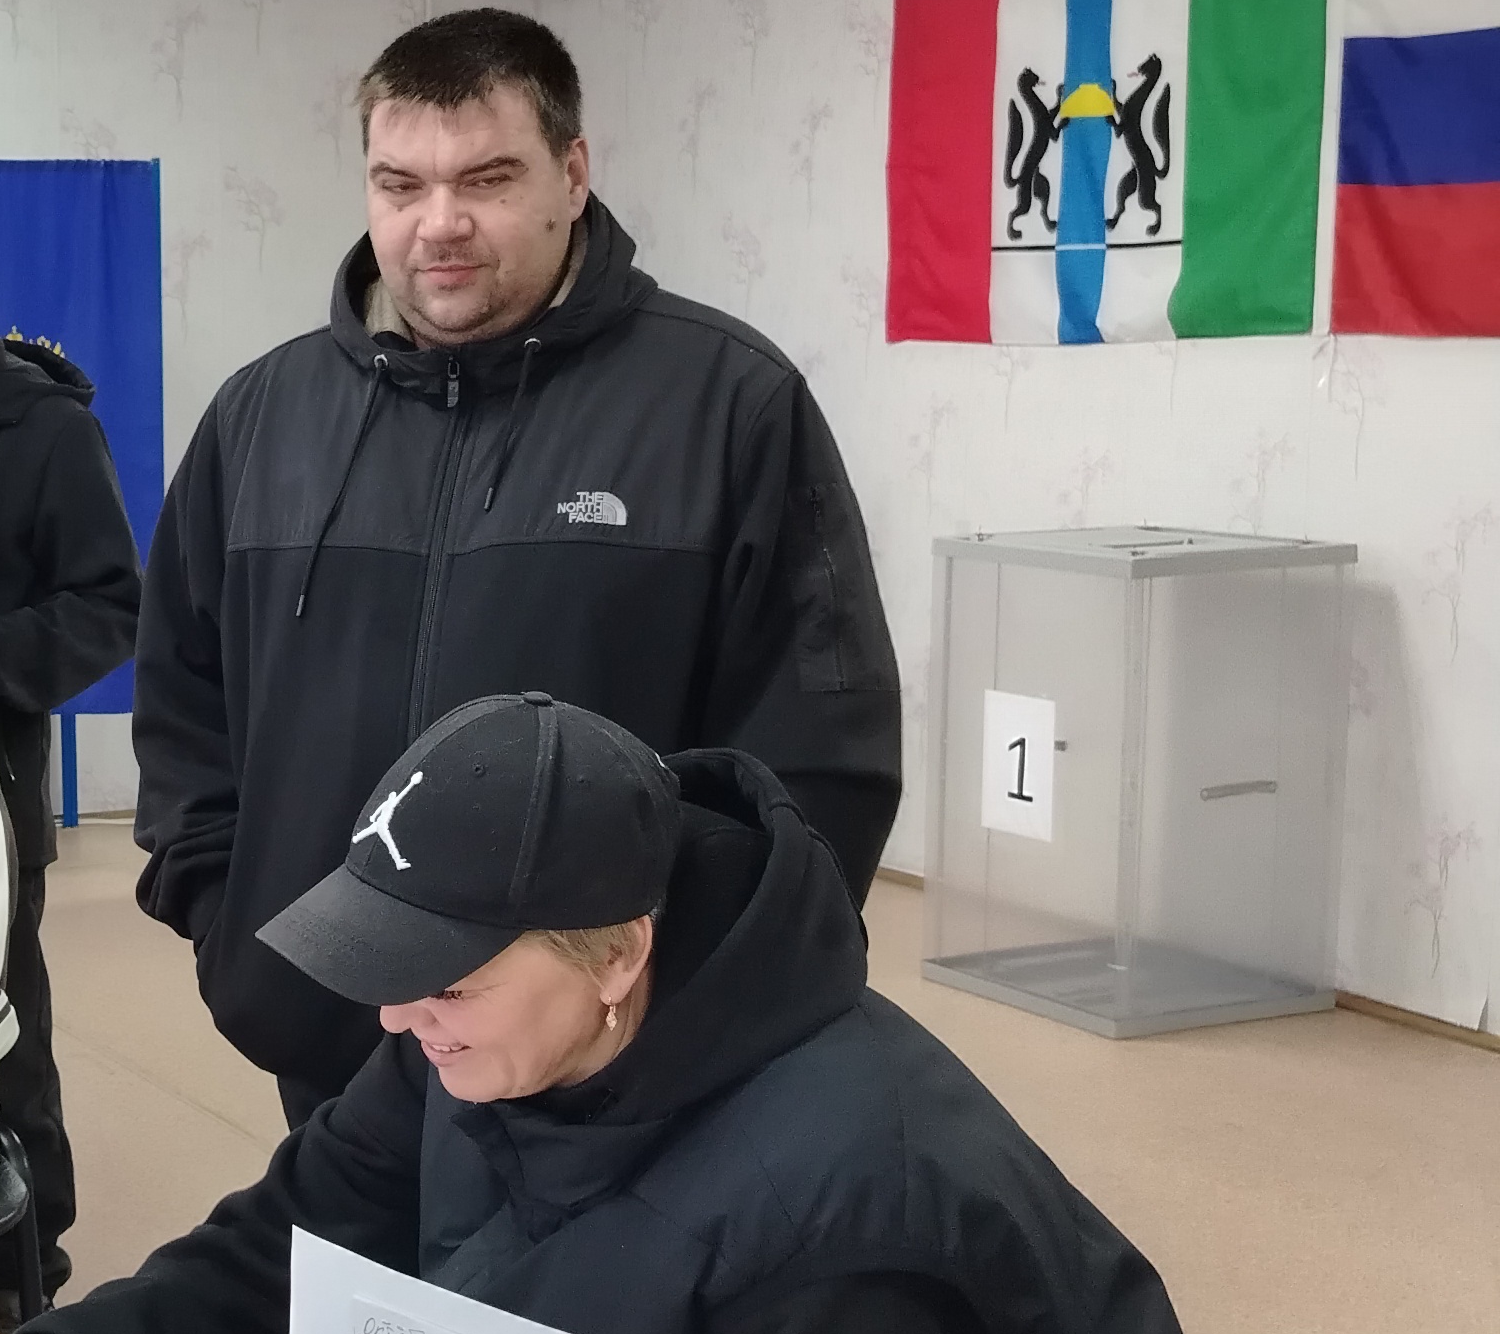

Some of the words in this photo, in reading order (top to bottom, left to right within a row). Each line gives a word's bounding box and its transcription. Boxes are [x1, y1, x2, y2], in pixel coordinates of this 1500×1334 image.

[576, 491, 604, 502] THE
[556, 501, 603, 514] NORTH
[568, 512, 603, 524] FACE
[1007, 736, 1034, 803] 1
